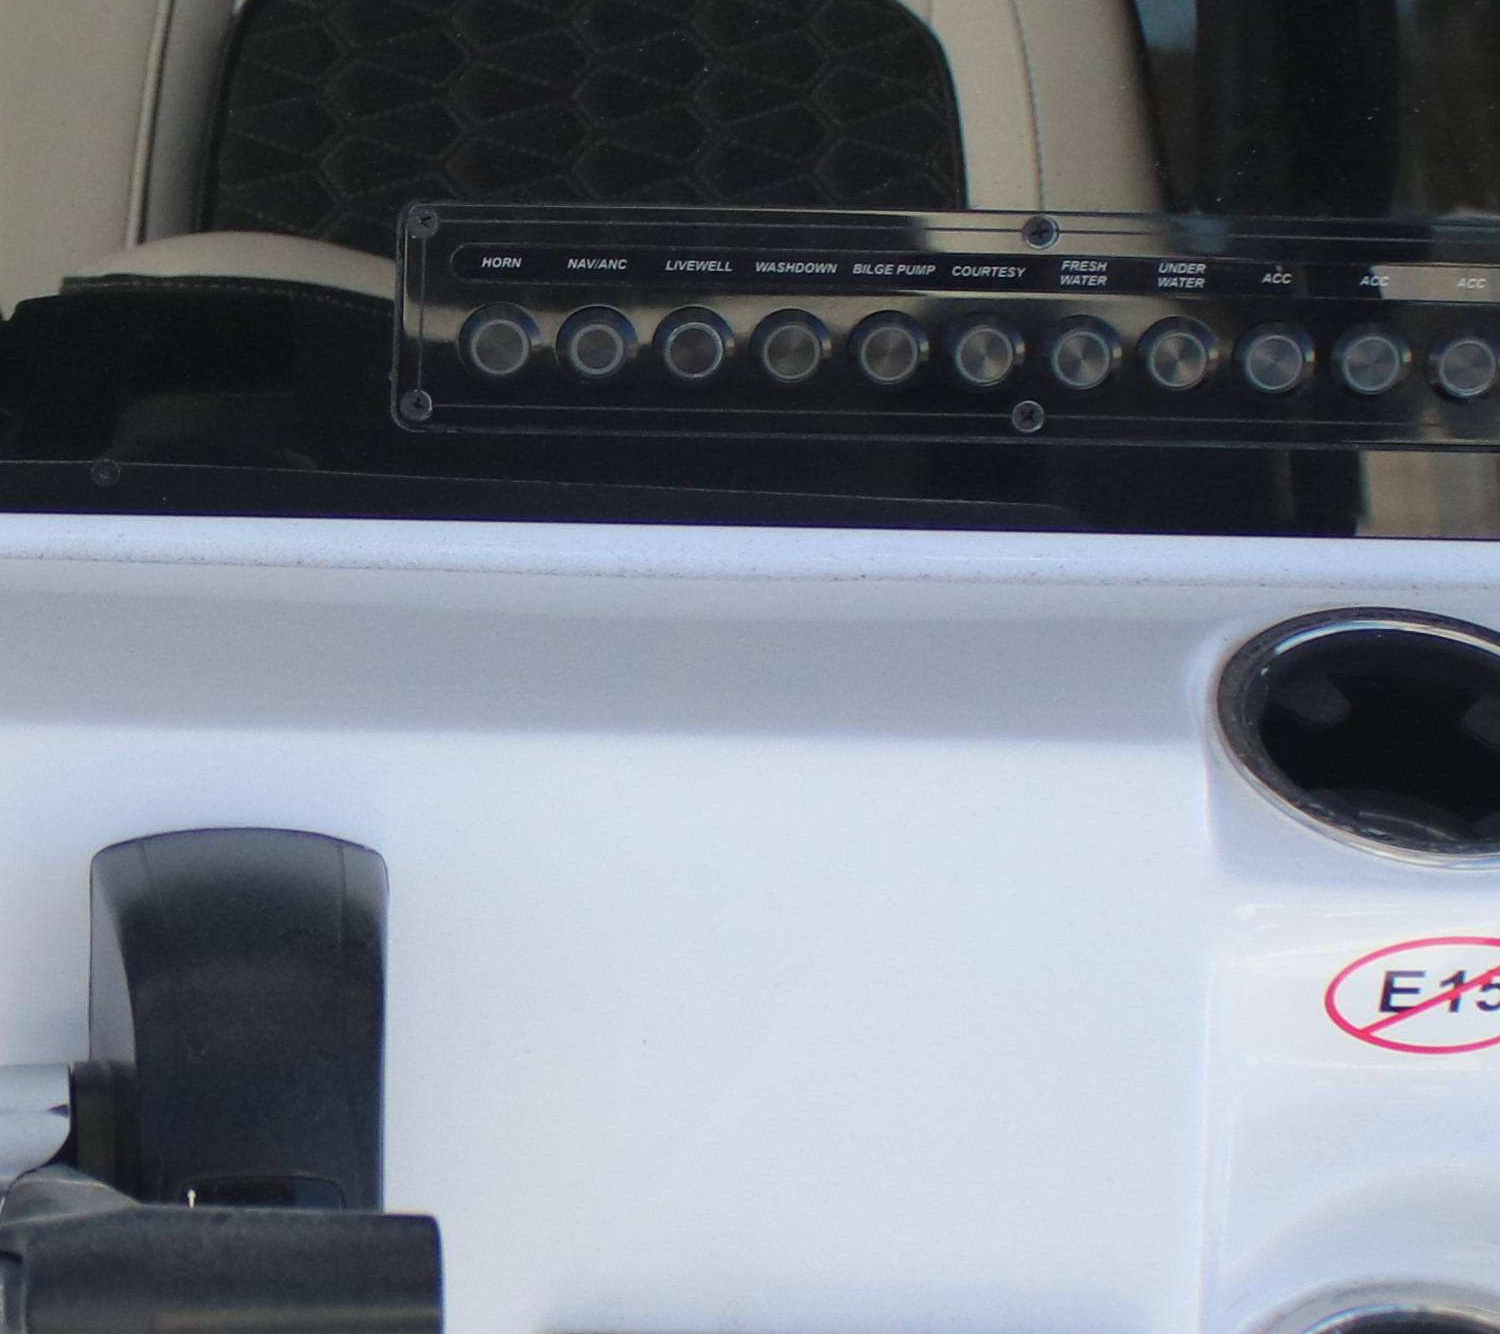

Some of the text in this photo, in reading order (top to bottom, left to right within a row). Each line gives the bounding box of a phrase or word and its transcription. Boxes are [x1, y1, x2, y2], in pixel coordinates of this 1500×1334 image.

[481, 256, 522, 269] HORN
[567, 257, 628, 271] NAV/ANC
[665, 259, 733, 273] LIVEWELL
[755, 261, 838, 275] WASHDOWN
[852, 263, 936, 276] BILGE PUMP
[1061, 260, 1108, 273] FRESH
[1158, 262, 1206, 275] UNDER
[951, 265, 1026, 280] COURTESY
[1262, 271, 1292, 285] ACC
[1059, 274, 1108, 287] WATER
[1157, 276, 1205, 290] WATER
[1359, 274, 1390, 288] ACC
[1456, 276, 1486, 290] ACC
